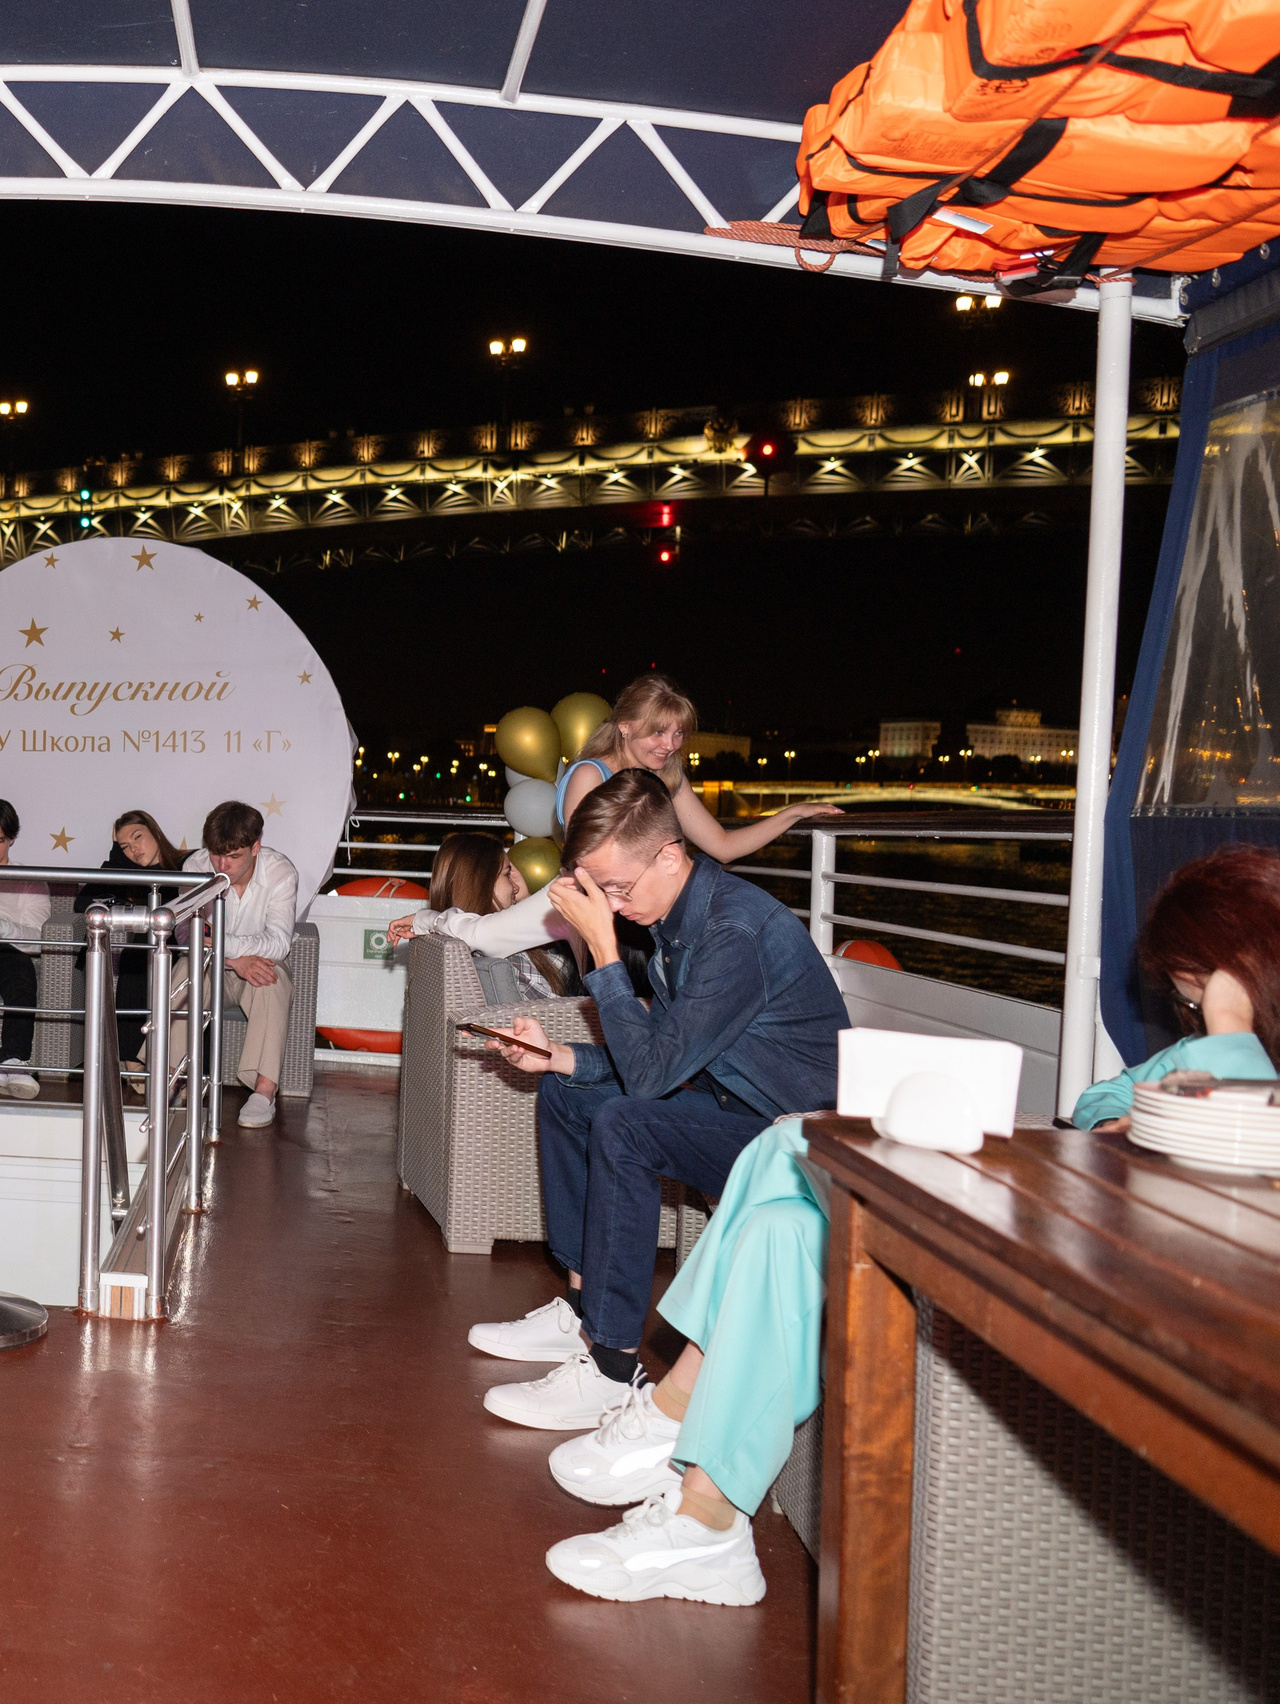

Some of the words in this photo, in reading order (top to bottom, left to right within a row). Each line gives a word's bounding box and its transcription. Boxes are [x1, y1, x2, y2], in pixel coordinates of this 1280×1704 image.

[20, 728, 112, 753] Школа
[224, 730, 242, 753] 11
[252, 730, 292, 754] «Г»
